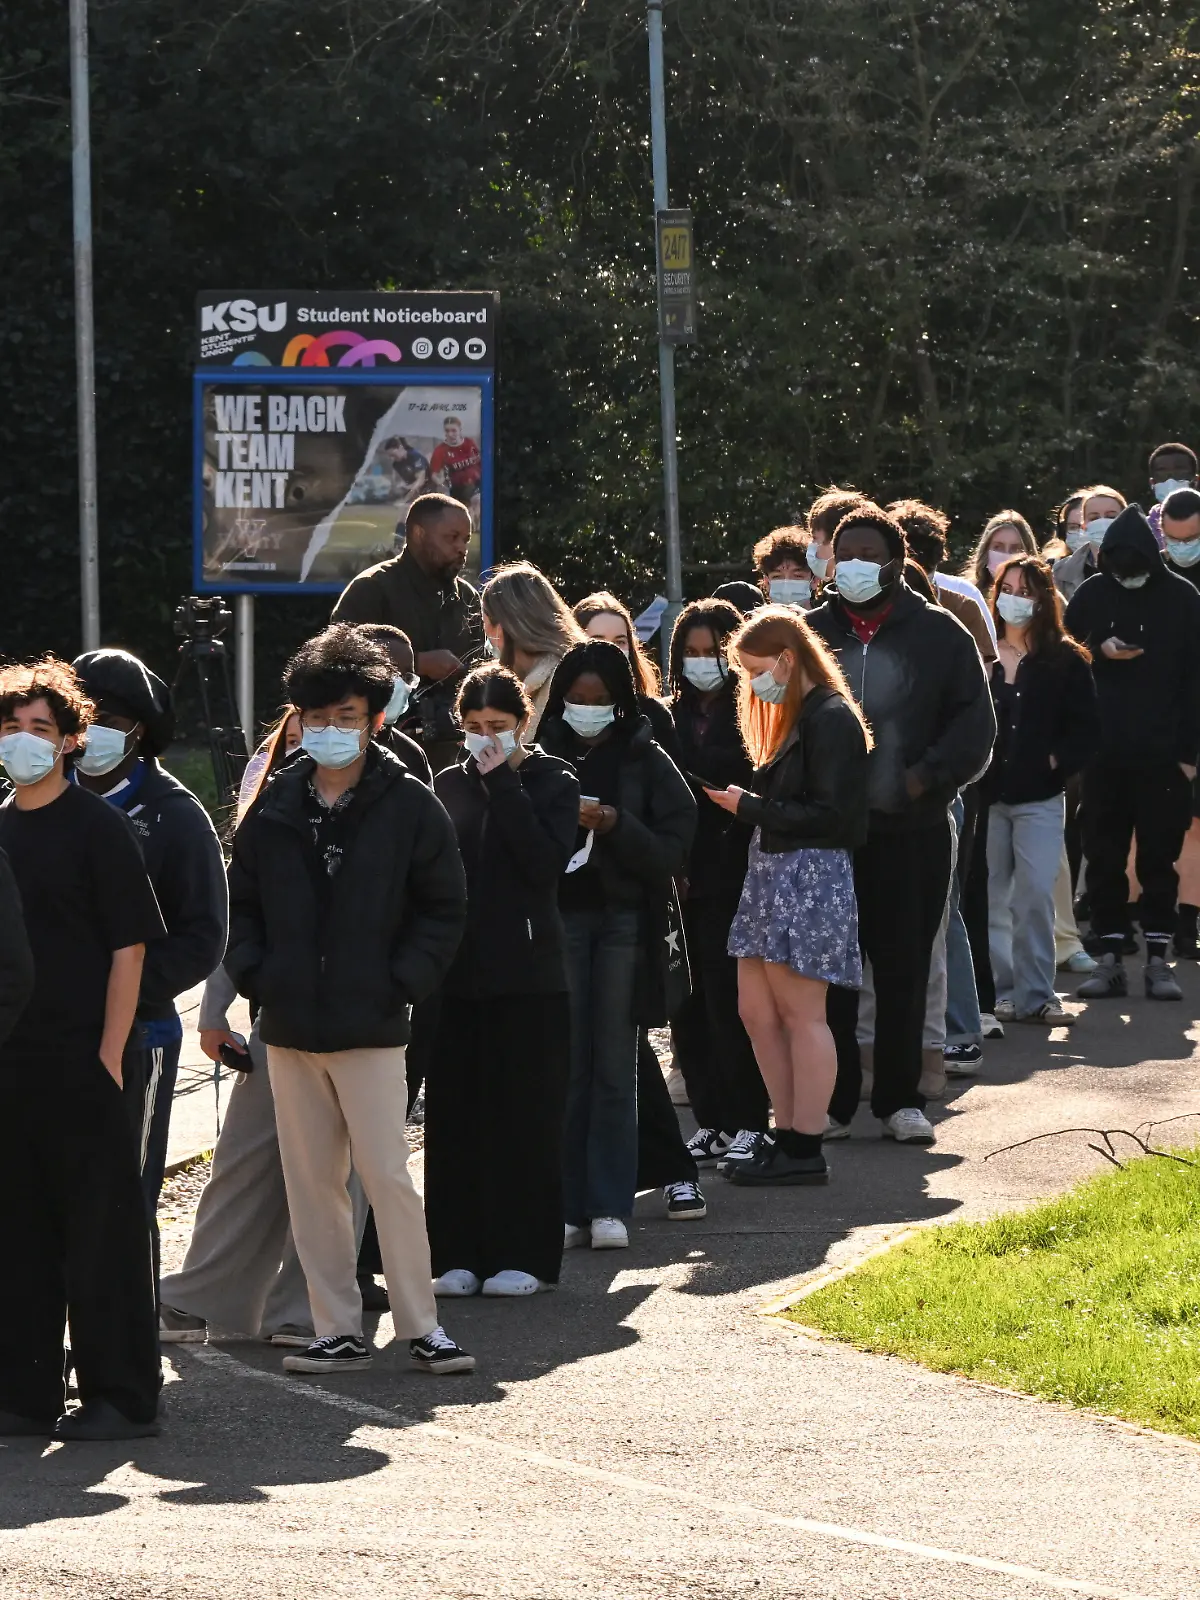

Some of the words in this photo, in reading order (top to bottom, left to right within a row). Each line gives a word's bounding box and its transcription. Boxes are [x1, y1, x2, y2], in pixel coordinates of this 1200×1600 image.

[664, 234, 688, 260] 24/7
[663, 272, 691, 286] SECURITY
[297, 307, 370, 323] Student
[374, 307, 487, 324] Noticeboard
[201, 332, 231, 345] KENT
[201, 345, 234, 358] UNION
[214, 394, 262, 432] WE
[268, 395, 347, 432] BACK
[214, 433, 295, 471] TEAM
[214, 471, 289, 509] KENT
